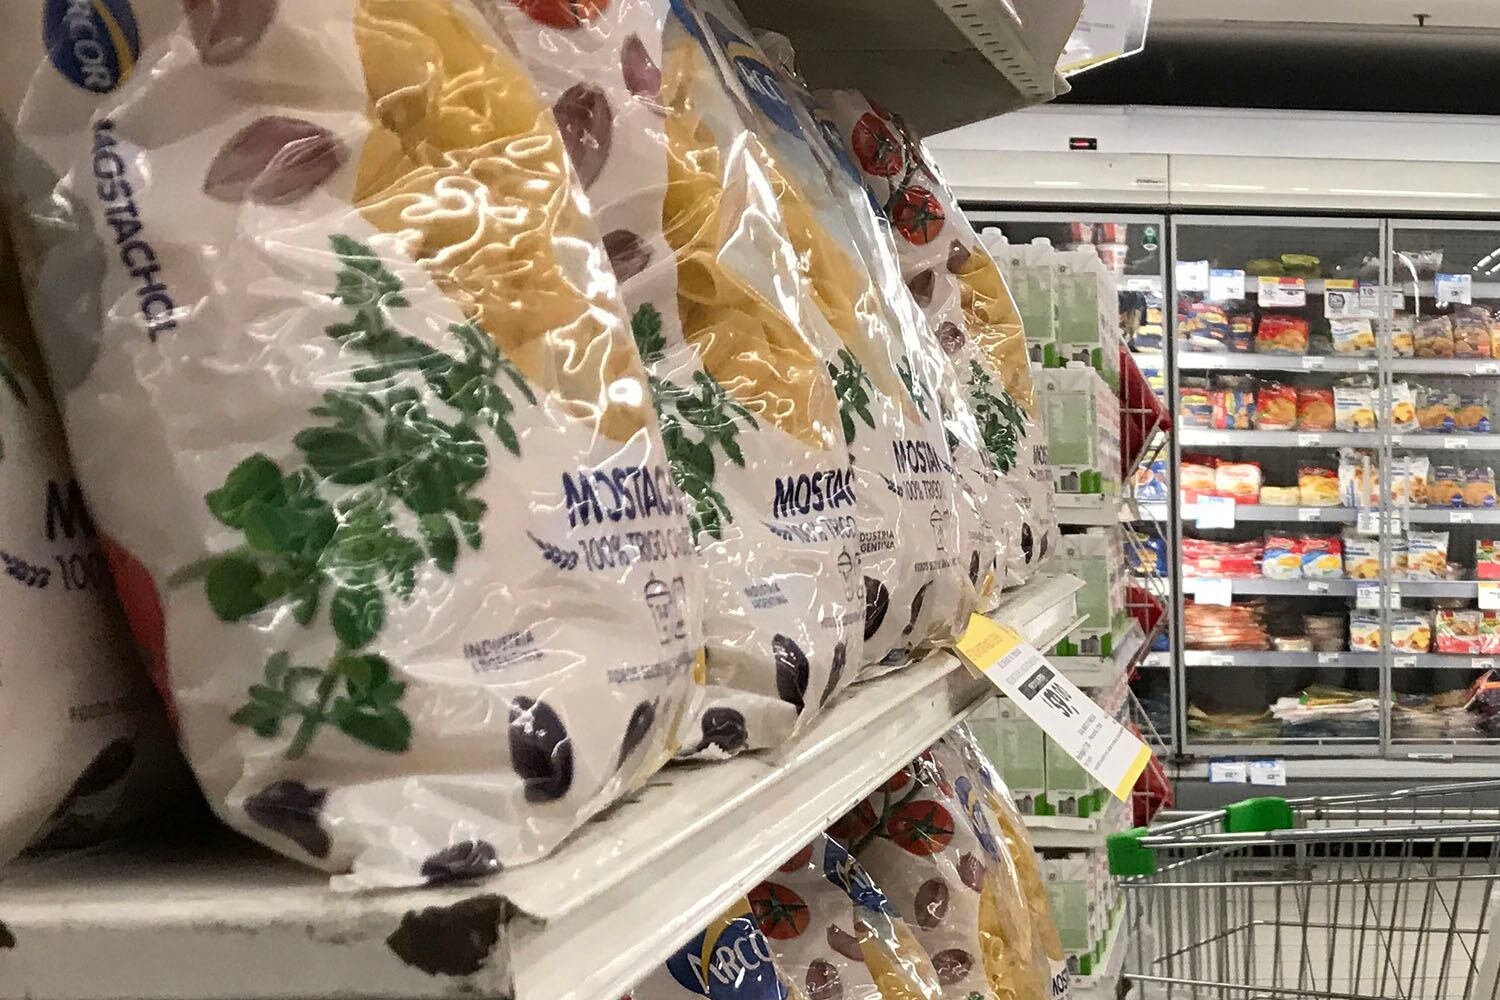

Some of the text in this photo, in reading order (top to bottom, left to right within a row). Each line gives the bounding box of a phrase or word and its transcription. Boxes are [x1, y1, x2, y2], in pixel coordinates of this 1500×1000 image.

[62, 0, 112, 87] RCOR
[860, 530, 895, 541] DUSTRIA
[860, 541, 896, 552] GENTINA
[687, 929, 774, 994] ARCO
